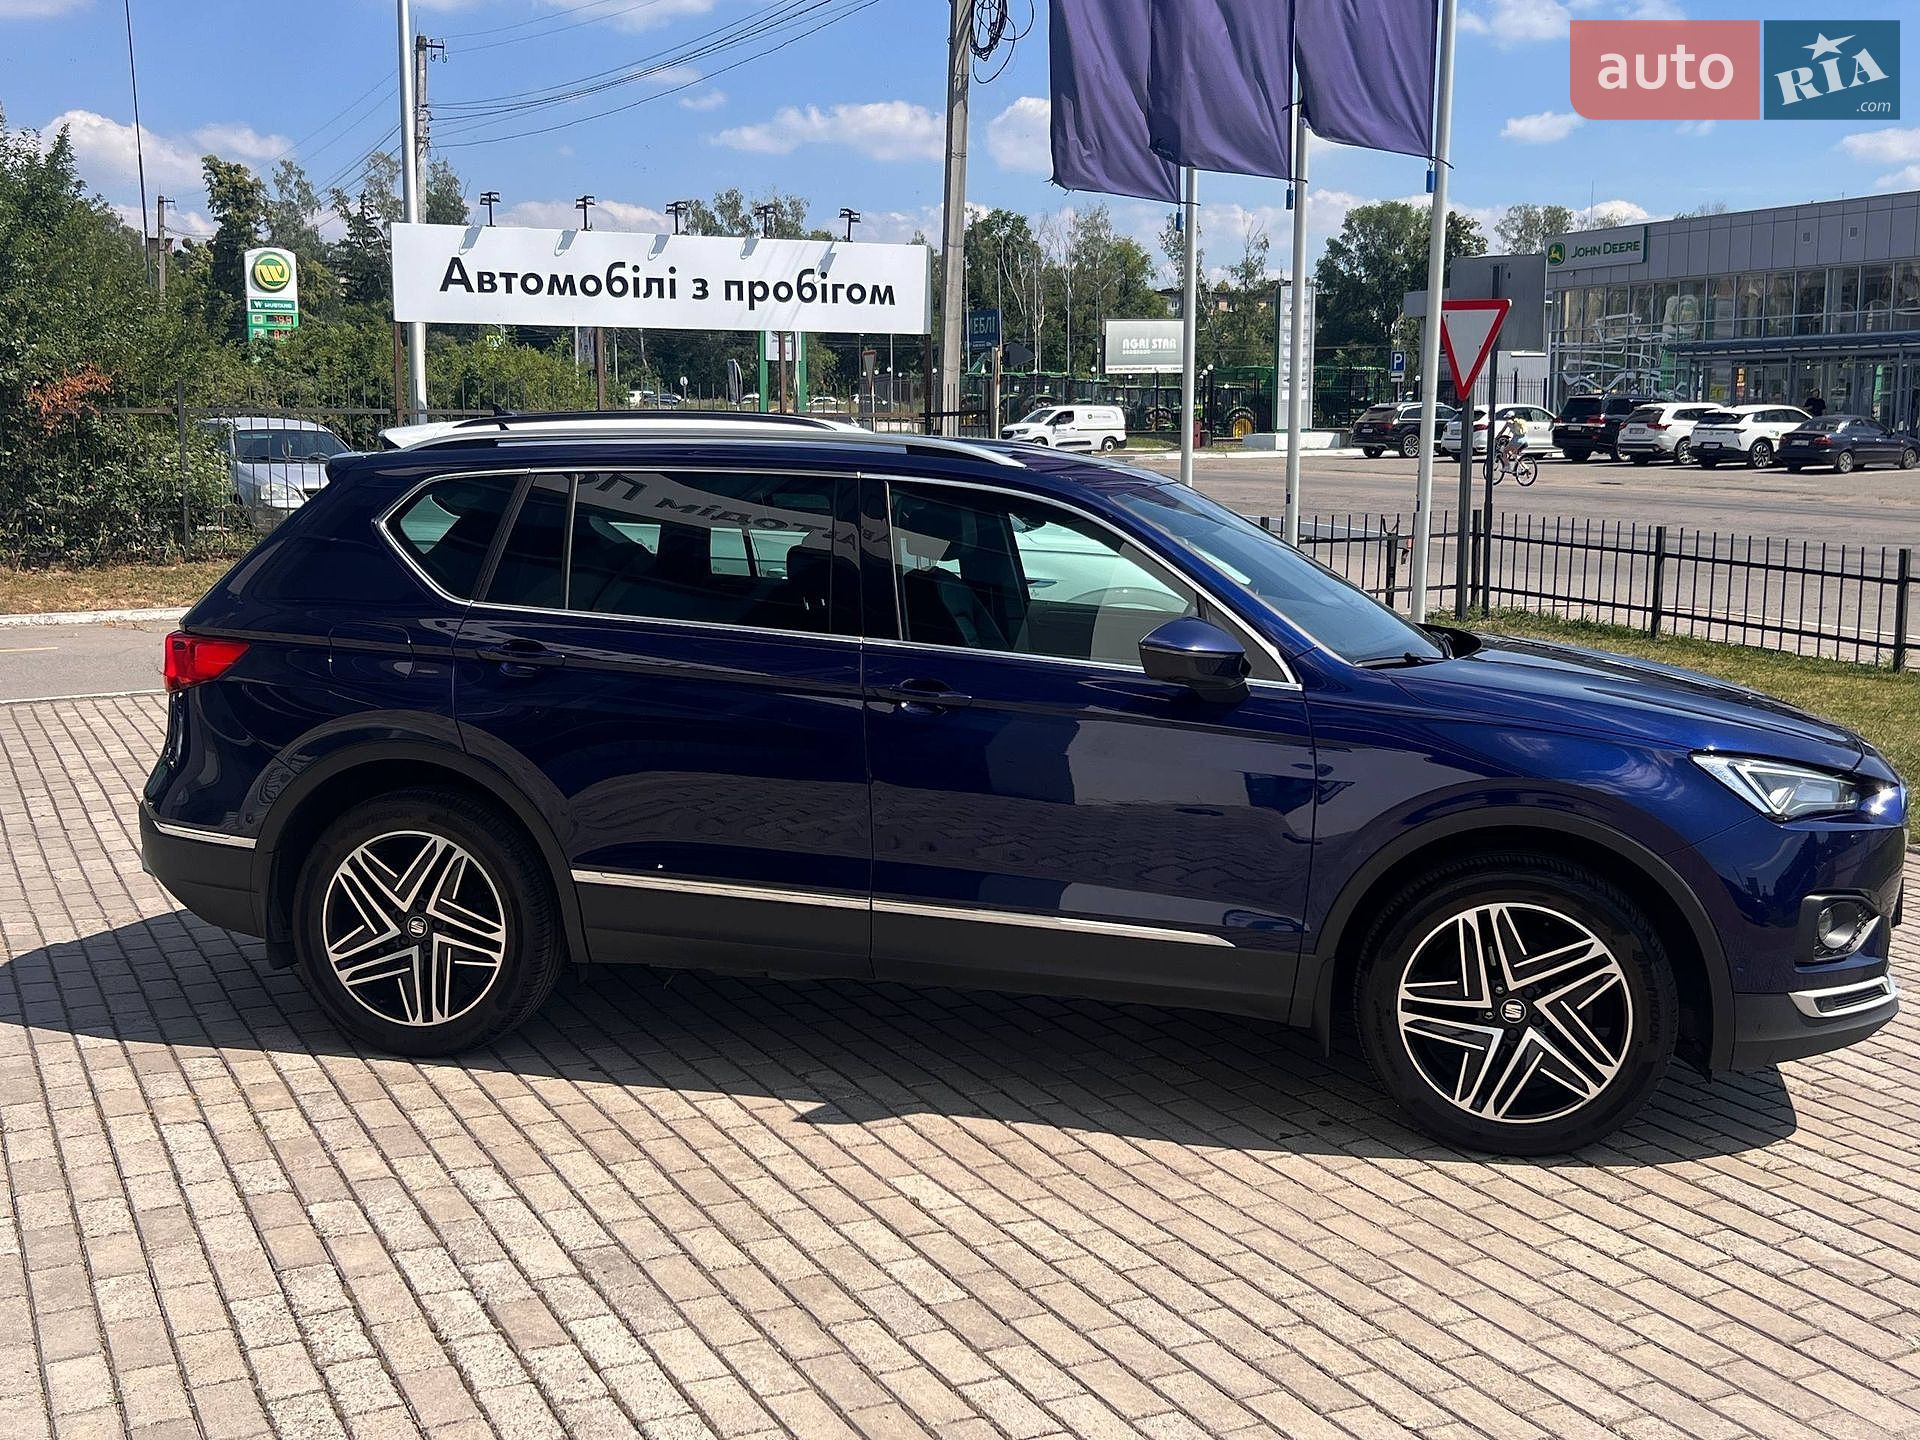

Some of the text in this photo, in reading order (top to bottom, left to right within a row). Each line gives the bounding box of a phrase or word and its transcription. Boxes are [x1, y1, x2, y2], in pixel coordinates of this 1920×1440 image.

[1571, 240, 1641, 258] JOHN DEERE
[439, 256, 896, 311] Автомобілі з пробігом
[1394, 353, 1403, 370] P
